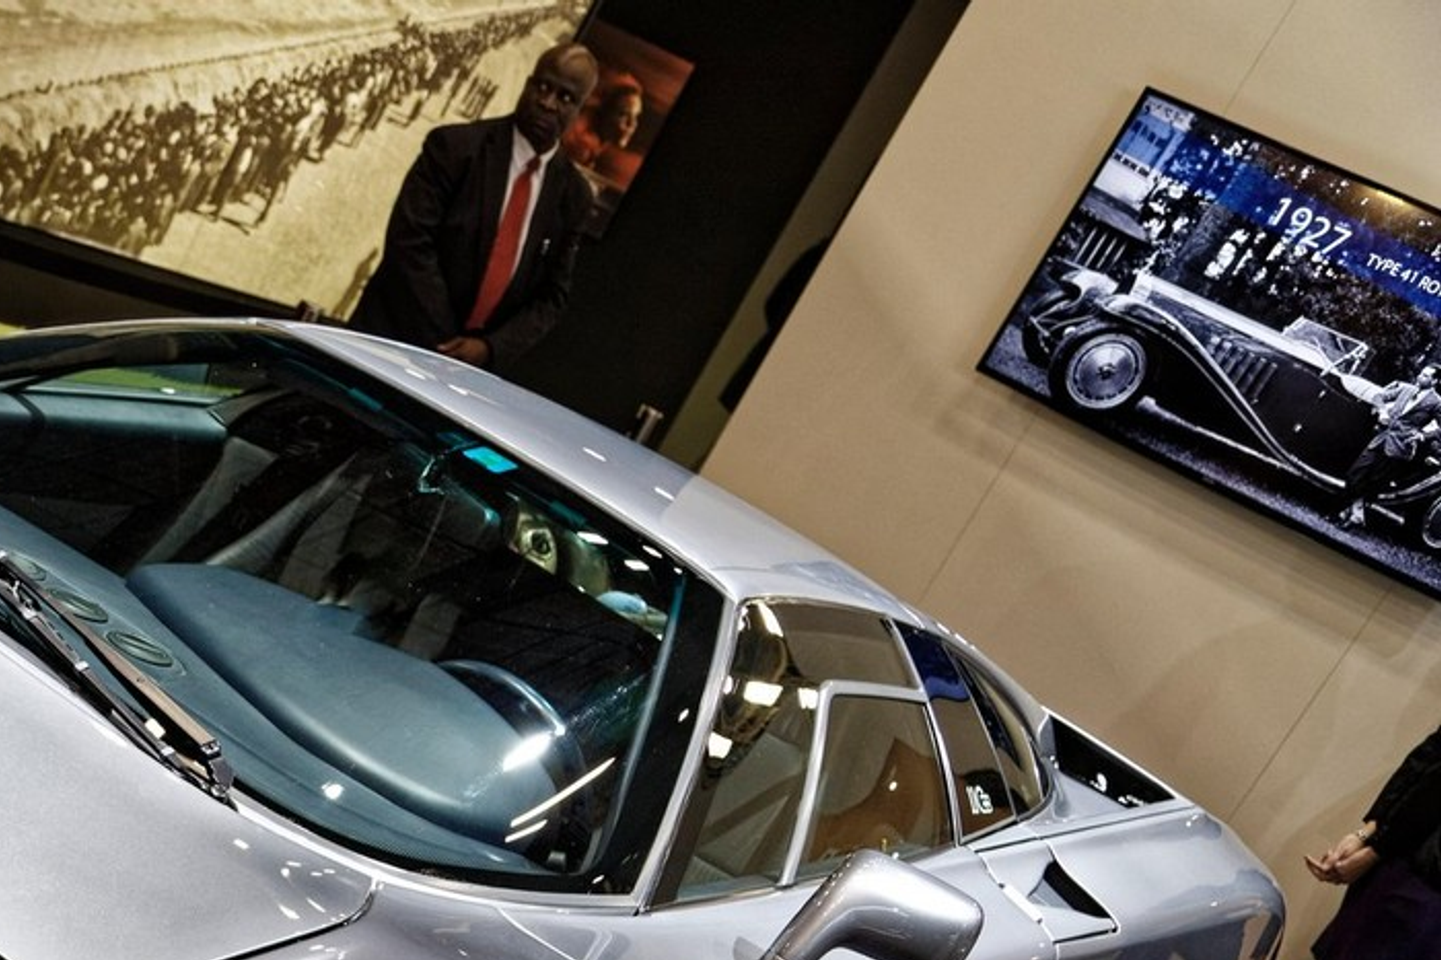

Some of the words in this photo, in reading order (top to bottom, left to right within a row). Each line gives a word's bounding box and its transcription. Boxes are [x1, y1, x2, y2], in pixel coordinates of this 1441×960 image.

[1267, 197, 1354, 255] 1927
[1366, 252, 1404, 278] TYPE
[1400, 267, 1420, 284] 41
[1417, 275, 1441, 297] RO
